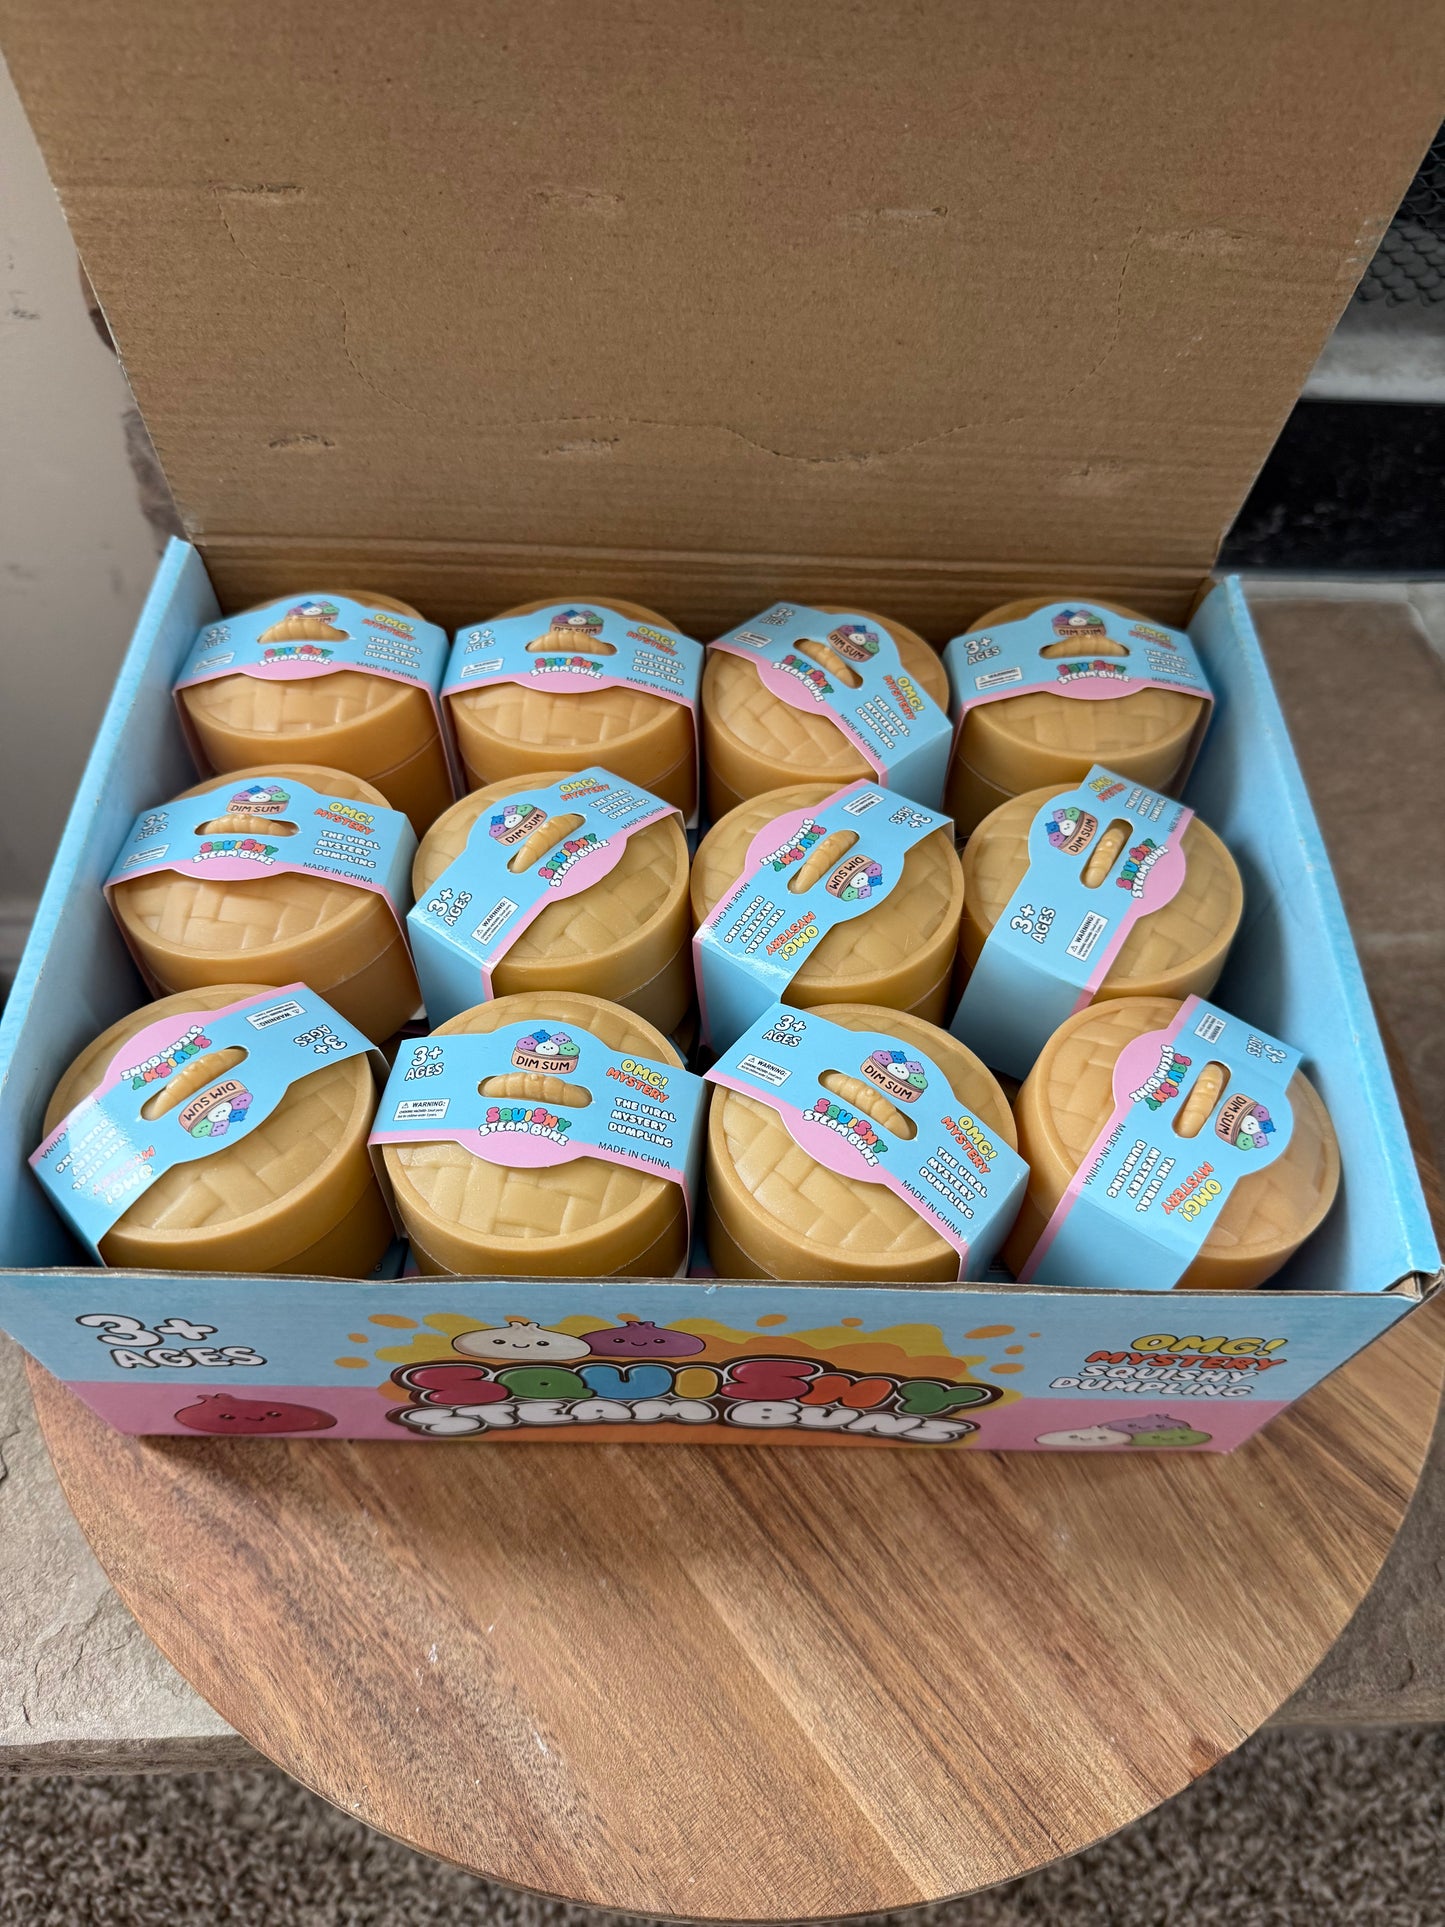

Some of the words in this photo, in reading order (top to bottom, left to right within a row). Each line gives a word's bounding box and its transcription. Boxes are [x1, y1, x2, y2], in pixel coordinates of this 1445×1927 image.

[374, 614, 415, 632] OMG!
[1058, 629, 1079, 637] DIM
[370, 636, 390, 645] THE
[392, 641, 423, 654] VIRAL
[464, 639, 495, 655] AGES
[469, 629, 493, 645] 3+
[626, 631, 678, 657] MYSTERY
[637, 626, 677, 647] OMG!
[829, 633, 846, 649] DIM
[843, 646, 865, 660] SUM
[964, 637, 992, 655] 3+
[258, 654, 298, 667] STEAM
[365, 651, 420, 668] DUMPLING
[367, 644, 414, 658] MYSTERY
[635, 650, 655, 660] THE
[657, 655, 686, 670] VIRAL
[967, 646, 1001, 666] AGES
[530, 666, 569, 677] STEAM
[572, 667, 603, 680] BUNZ
[631, 665, 684, 685] DUMPLING
[633, 657, 678, 675] MYSTERY
[1057, 670, 1097, 685] STEAM
[1098, 670, 1130, 682] BUNZ
[626, 676, 648, 687] MADE
[650, 682, 659, 690] IN
[660, 685, 684, 698] CHINA
[771, 661, 805, 681] STEAM
[803, 678, 825, 702] BUNZ
[883, 674, 917, 721] MYSTERY
[897, 676, 925, 713] OMG!
[863, 701, 899, 737] MYSTERY
[873, 694, 890, 713] THE
[888, 710, 911, 737] VIRAL
[840, 713, 858, 733] MADE
[856, 731, 865, 741] IN
[863, 739, 882, 761] CHINA
[855, 706, 895, 750] DUMPLING
[559, 778, 599, 792] OMG!
[560, 784, 610, 802] MYSTERY
[230, 805, 251, 813] DIM
[253, 805, 281, 813] SUM
[329, 802, 375, 825] OMG!
[908, 812, 933, 829] 3+
[143, 812, 169, 831] 3+
[314, 808, 375, 835] MYSTERY
[505, 828, 525, 844] DIM
[523, 813, 544, 830] SUM
[787, 818, 815, 847] STEAM
[317, 839, 371, 856] MYSTERY
[321, 830, 344, 841] THE
[347, 835, 381, 850] VIRAL
[1068, 836, 1087, 853] DIM
[1082, 818, 1096, 838] SUM
[192, 850, 237, 864] STEAM
[239, 851, 276, 866] BUNZ
[314, 848, 376, 869] DUMPLING
[549, 854, 580, 887] STEAM
[577, 839, 610, 858] BUNZ
[760, 843, 792, 867] BUNZ
[844, 856, 865, 872] DIM
[303, 862, 330, 872] MADE
[332, 868, 342, 876] IN
[344, 871, 373, 884] CHINA
[829, 870, 849, 890] SUM
[1131, 865, 1150, 899] STEAM
[1144, 844, 1169, 866] BUNZ
[427, 888, 453, 917] 3+
[734, 882, 751, 903] MADE
[444, 891, 472, 926] AGES
[482, 900, 508, 927] WARNING:
[724, 902, 735, 912] IN
[767, 908, 786, 928] THE
[1010, 904, 1035, 934] 3+
[724, 895, 765, 944] DUMPLING
[739, 901, 775, 944] MYSTERY
[1031, 907, 1056, 944] AGES
[1075, 914, 1096, 943] WARNING:
[745, 926, 770, 954] VIRAL
[765, 911, 816, 956] MYSTERY
[778, 925, 819, 961] OMG!
[256, 1012, 292, 1028] WARNING:
[774, 1014, 806, 1033] 3+
[160, 1025, 204, 1059] STEAM
[293, 1024, 332, 1047] AGES
[313, 1034, 348, 1054] 3+
[762, 1030, 801, 1047] AGES
[119, 1055, 161, 1081] BUNZ
[411, 1045, 443, 1067] 3+
[516, 1056, 539, 1069] DIM
[542, 1060, 570, 1071] SUM
[1153, 1044, 1176, 1080] STEAM
[404, 1062, 444, 1081] AGES
[621, 1059, 669, 1089] OMG!
[758, 1061, 787, 1077] WARNING:
[210, 1081, 237, 1100] DIM
[606, 1067, 669, 1103] MYSTERY
[863, 1065, 885, 1084] DIM
[887, 1081, 912, 1100] SUM
[1128, 1076, 1161, 1103] BUNZ
[184, 1098, 211, 1121] SUM
[615, 1097, 639, 1111] THE
[641, 1104, 676, 1122] VIRAL
[1230, 1095, 1247, 1114] DIM
[610, 1110, 667, 1132] MYSTERY
[1218, 1112, 1236, 1136] SUM
[41, 1132, 67, 1159] CHINA
[478, 1121, 530, 1136] STEAM
[530, 1123, 569, 1146] BUNZ
[608, 1123, 673, 1148] DUMPLING
[802, 1109, 848, 1137] STEAM
[847, 1132, 879, 1167] BUNZ
[941, 1116, 991, 1174] MYSTERY
[958, 1115, 998, 1162] OMG!
[1106, 1122, 1127, 1148] MADE
[599, 1142, 626, 1156] MADE
[628, 1149, 639, 1158] IN
[641, 1153, 670, 1169] CHINA
[1099, 1147, 1110, 1159] IN
[927, 1157, 975, 1201] MYSTERY
[936, 1147, 959, 1169] THE
[957, 1165, 989, 1198] VIRAL
[1082, 1157, 1105, 1186] CHINA
[1106, 1138, 1147, 1199] DUMPLING
[1126, 1146, 1162, 1199] MYSTERY
[1156, 1156, 1176, 1180] THE
[919, 1167, 974, 1219] DUMPLING
[1135, 1178, 1163, 1213] VIRAL
[1161, 1161, 1215, 1215] MYSTERY
[901, 1180, 927, 1204] MADE
[926, 1201, 937, 1214] IN
[936, 1211, 962, 1238] CHINA
[1178, 1179, 1223, 1222] OMG!
[75, 1313, 218, 1347] 3+
[1130, 1333, 1289, 1356] OMG!
[110, 1346, 268, 1369] AGES
[1084, 1350, 1288, 1371] MYSTERY
[1078, 1365, 1259, 1384] SQUISHY
[395, 1356, 1000, 1418] SQUISHY
[1049, 1376, 1255, 1398] DUMPLING
[396, 1399, 718, 1437] STEAM
[722, 1399, 983, 1443] BUNZ
